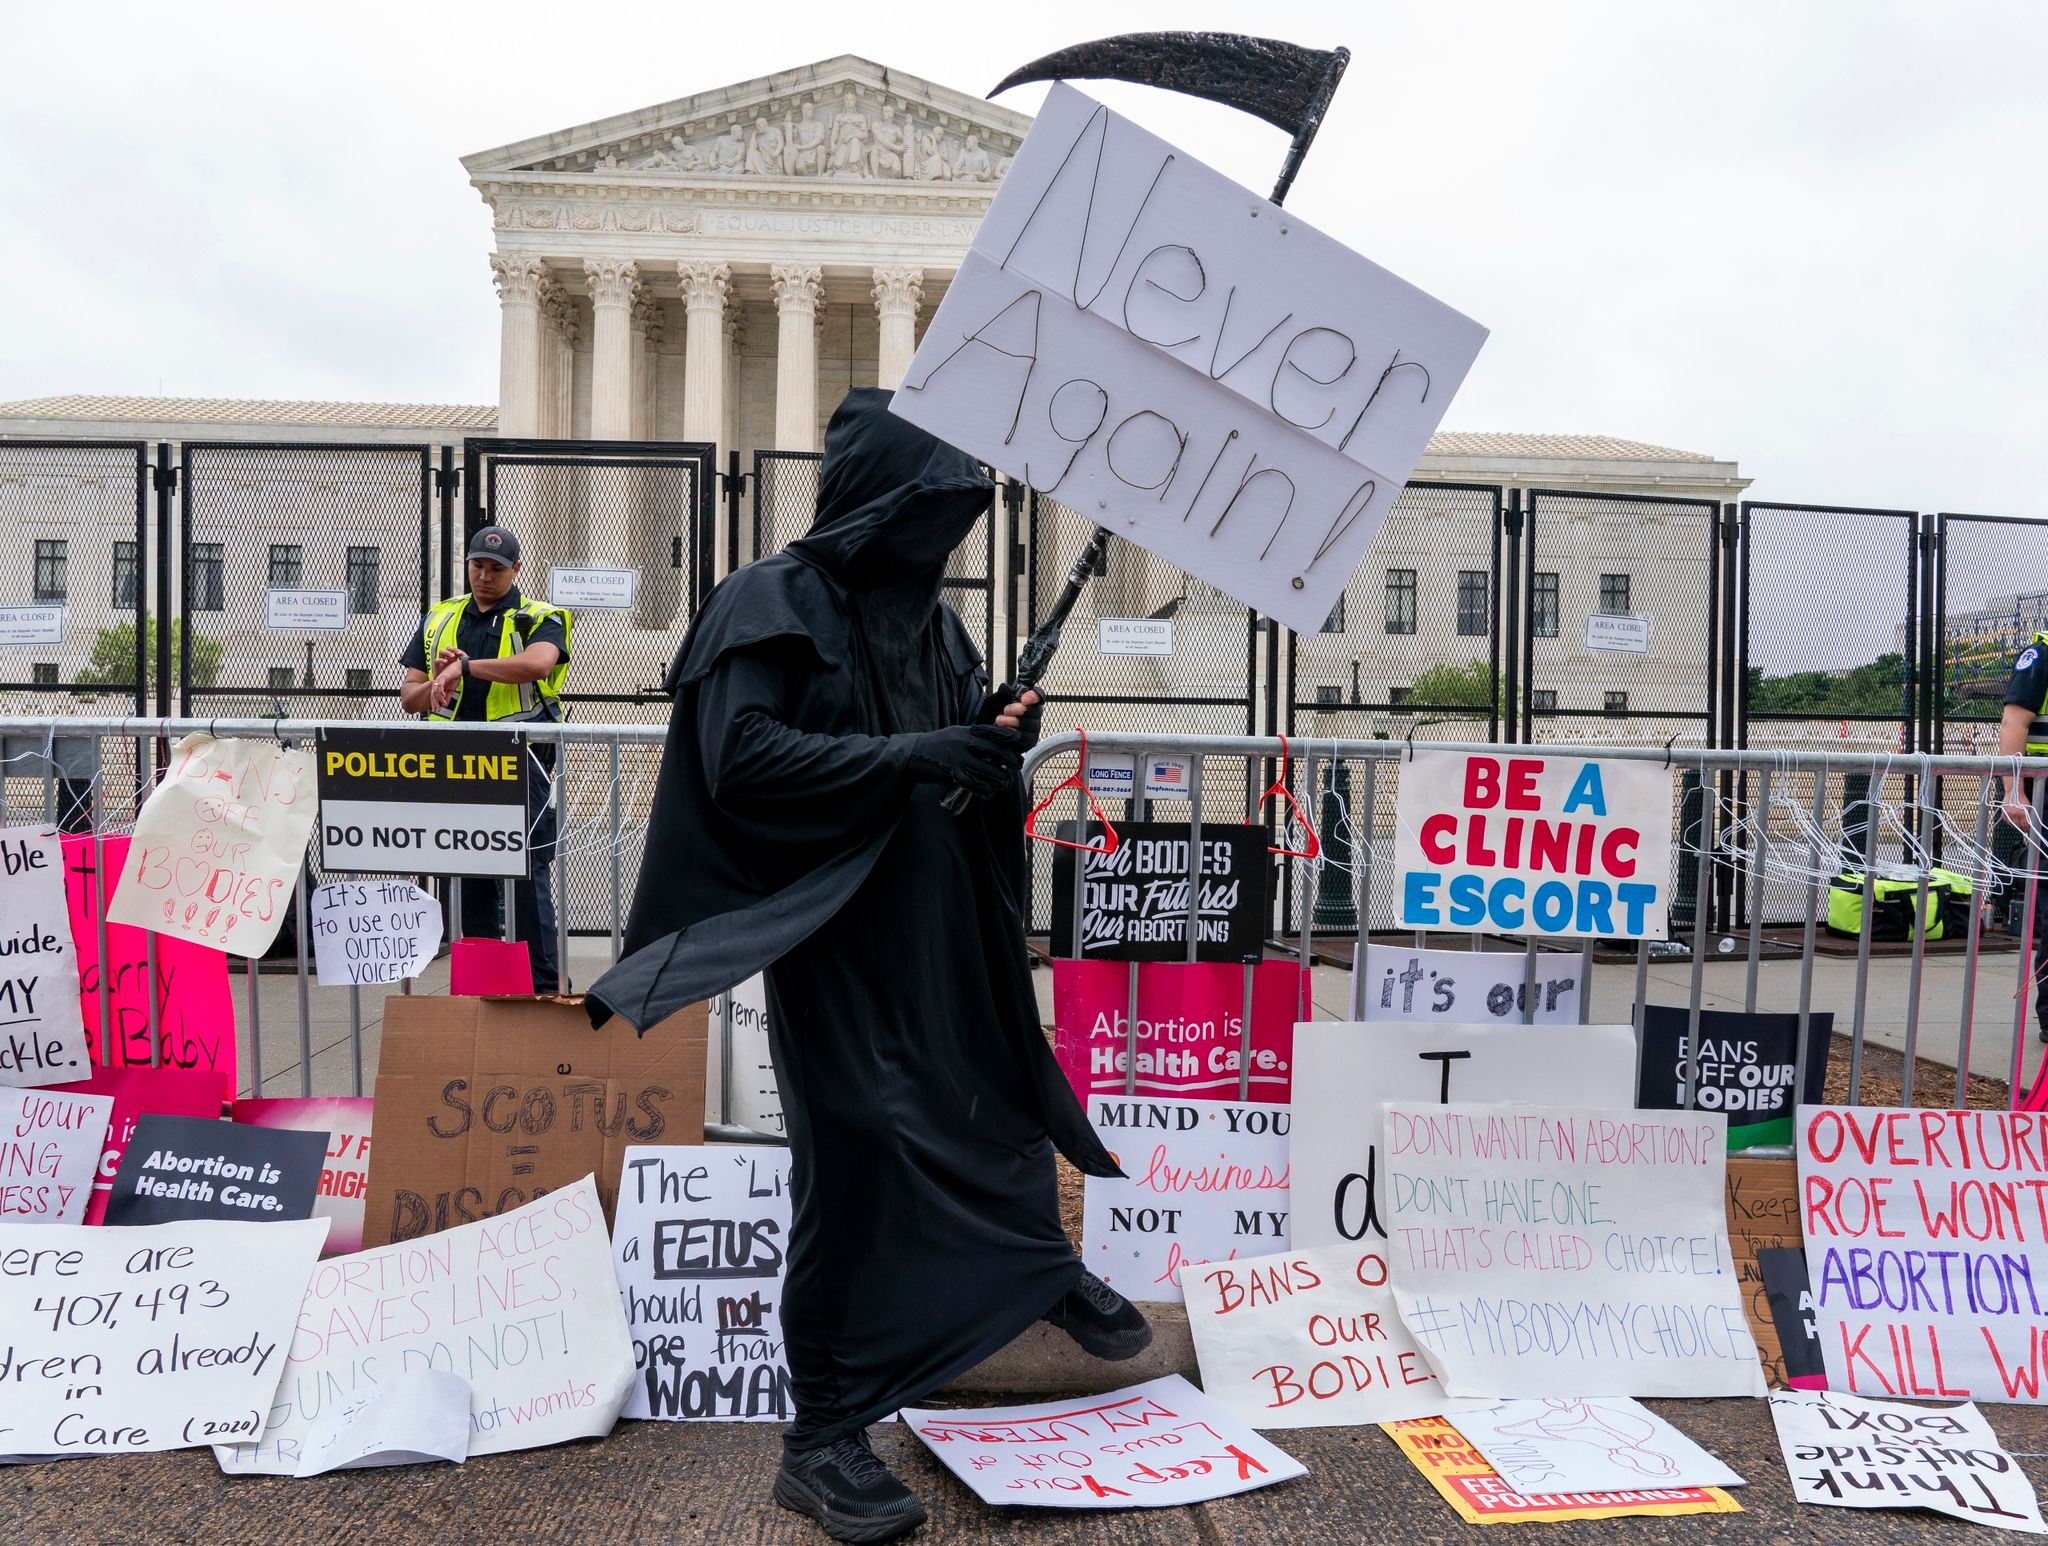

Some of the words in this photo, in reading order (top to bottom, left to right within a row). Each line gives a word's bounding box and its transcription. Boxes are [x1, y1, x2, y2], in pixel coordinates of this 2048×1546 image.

[717, 215, 780, 232] EQUAL
[788, 216, 862, 235] JUSTICE
[871, 219, 935, 238] UNDER
[943, 222, 978, 239] LAW
[1001, 105, 1430, 450] Never
[906, 290, 1375, 590] Again!
[562, 575, 586, 584] AREA
[590, 576, 625, 585] CLOSED
[21, 612, 55, 622] CLOSED
[276, 596, 299, 605] AREA
[302, 597, 338, 606] CLOSED
[1108, 625, 1130, 633] AREA
[1134, 625, 1166, 634] CLOSED
[1594, 621, 1615, 630] AREA
[1618, 623, 1644, 633] CLOSED
[176, 742, 304, 806] BANS
[326, 752, 436, 779] POLICE
[446, 755, 519, 781] LINE
[1091, 769, 1109, 779] LONG
[1110, 770, 1132, 780] FENCE
[1146, 785, 1188, 793] longfence.com
[1463, 756, 1545, 812] BE
[1562, 762, 1607, 817] A
[326, 825, 364, 847] DO
[373, 827, 427, 849] NOT
[434, 829, 524, 853] CROSS
[1420, 813, 1640, 879] CLINIC
[1136, 840, 1232, 876] BODES
[321, 884, 368, 910] It's
[377, 882, 420, 904] time
[1403, 871, 1657, 936] ESCORT
[314, 916, 338, 937] to
[349, 912, 385, 933] use
[391, 911, 428, 930] our
[345, 936, 419, 961] OUTSIDE
[1381, 958, 1456, 1013] it's
[1090, 1009, 1215, 1043] Abortion
[1224, 1012, 1243, 1037] is
[1090, 1046, 1199, 1078] Health
[1208, 1046, 1288, 1073] Care.
[1738, 1064, 1796, 1088] OUR
[16, 1096, 95, 1138] your
[426, 1079, 674, 1142] SCOTUS
[1099, 1102, 1200, 1131] MIND
[1389, 1111, 1464, 1159] DON'T
[1470, 1114, 1540, 1161] WANT
[1537, 1117, 1575, 1164] AN
[1584, 1119, 1716, 1166] ABORTION?
[142, 1150, 254, 1182] Abortion
[258, 1162, 282, 1185] is
[628, 1157, 712, 1204] The
[0, 1185, 76, 1220] ESS!
[135, 1175, 214, 1203] Health
[220, 1186, 284, 1213] Care.
[1392, 1173, 1470, 1217] DON'T
[1484, 1177, 1549, 1225] HAVE
[1551, 1181, 1617, 1225] ONE.
[1728, 1173, 1801, 1225] Keep
[1805, 1175, 1906, 1237] ROE
[1109, 1207, 1182, 1234] NOT
[1234, 1210, 1288, 1237] MY
[125, 1245, 195, 1274] are
[304, 1237, 452, 1301] ORTION
[476, 1190, 593, 1270] ACCESS
[622, 1236, 640, 1263] a
[653, 1218, 783, 1275] FETUS
[1397, 1225, 1493, 1273] THAT'S
[1503, 1230, 1593, 1271] CALLED
[1604, 1232, 1723, 1276] CHOICE!
[1204, 1261, 1322, 1316] BANS
[1819, 1247, 2048, 1317] ABORTION
[33, 1280, 231, 1332] 407,493
[287, 1289, 430, 1363] SAVES
[451, 1255, 578, 1327] LIVES,
[468, 1309, 569, 1380] NOT!
[1308, 1313, 1388, 1347] OUR
[1408, 1296, 1758, 1362] #MYBODYMYCHOICE
[136, 1331, 277, 1377] already
[1839, 1321, 1972, 1400] KILL
[1980, 1326, 2048, 1400] W
[64, 1383, 103, 1401] in
[1252, 1351, 1437, 1409] BODIE
[506, 1379, 598, 1425] wombs
[1097, 1399, 1180, 1434] MY
[53, 1413, 150, 1446] Care
[182, 1410, 261, 1444] (2020)
[919, 1420, 1091, 1443] UTERUS
[1100, 1421, 1223, 1457] Laws
[1871, 1433, 1943, 1447] MY
[968, 1454, 997, 1472] of
[1014, 1449, 1094, 1471] Out
[1126, 1444, 1269, 1484] Keep
[1794, 1444, 2010, 1473] Outside
[1005, 1474, 1133, 1498] Your
[1798, 1468, 2030, 1520] Think
